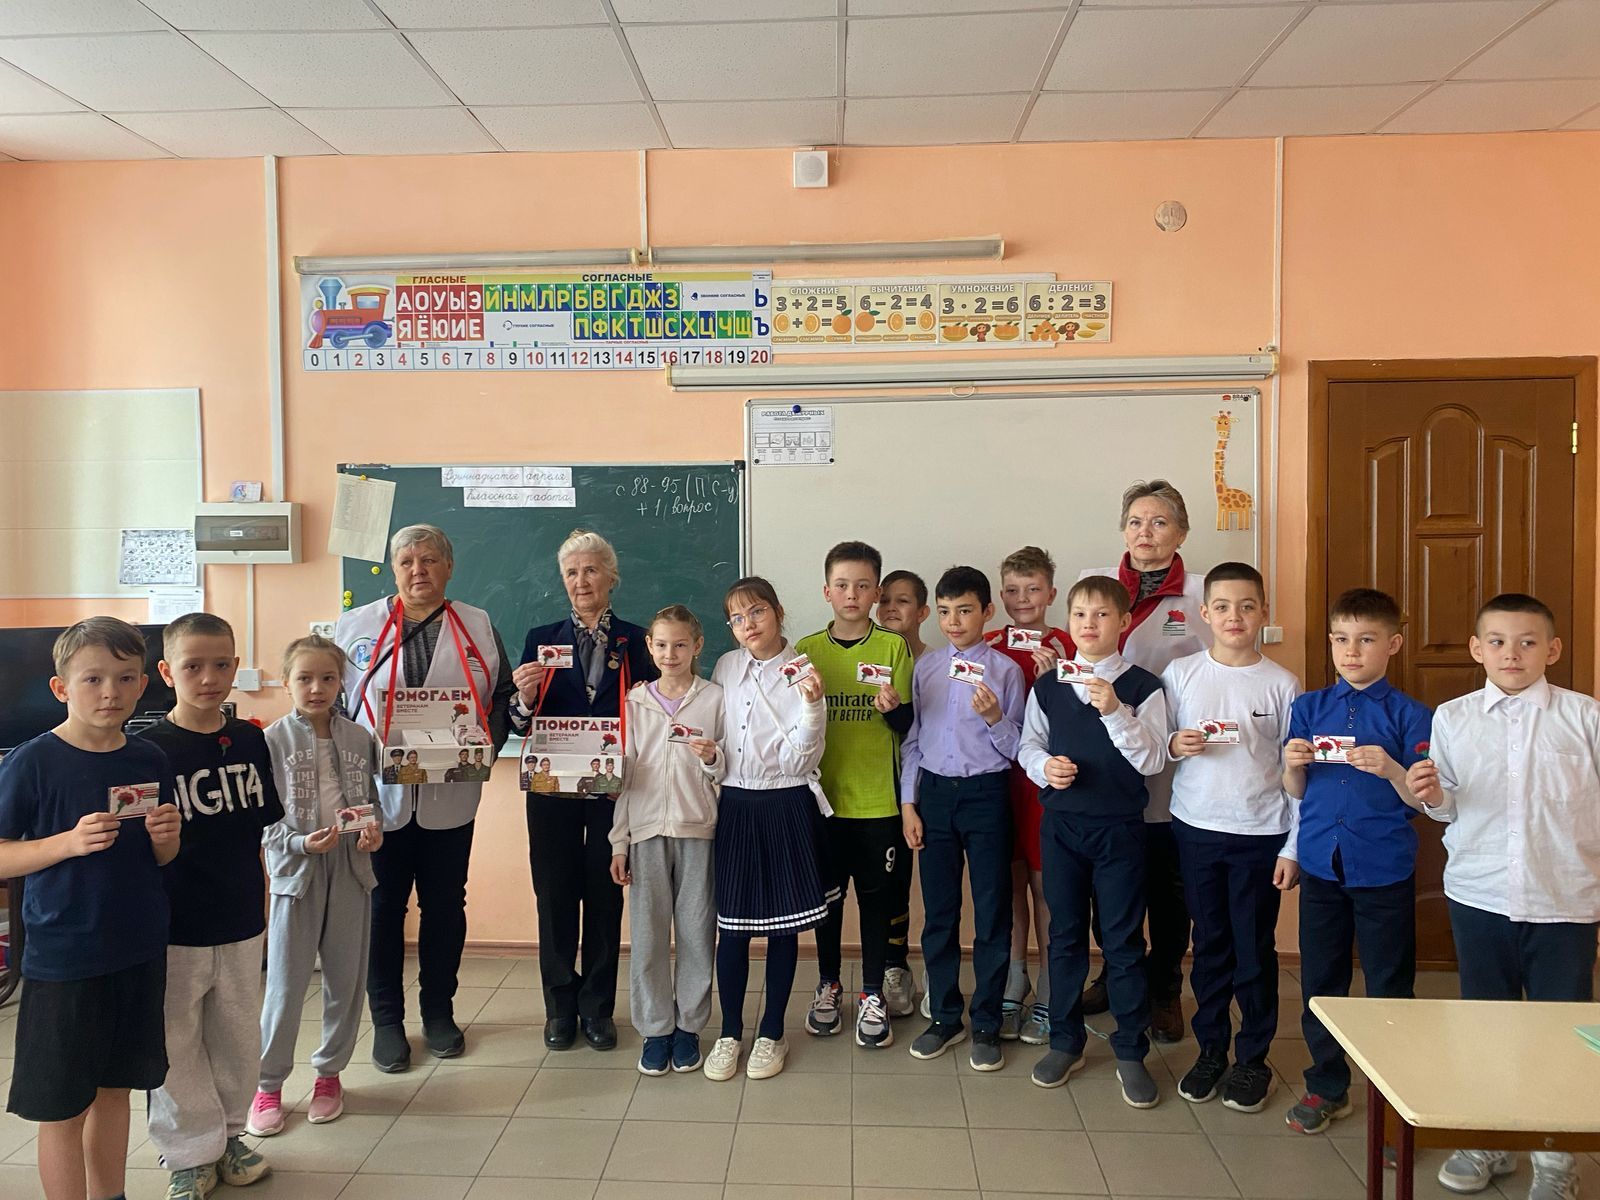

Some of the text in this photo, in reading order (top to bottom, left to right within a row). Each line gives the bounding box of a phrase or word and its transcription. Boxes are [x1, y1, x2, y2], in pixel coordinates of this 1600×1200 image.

[412, 275, 467, 285] ГЛАСНЫЕ
[582, 273, 653, 283] СОГЛАСНЫЕ
[790, 287, 839, 295] СЛОЖЕНИЕ
[871, 284, 927, 293] ВЫЧИТАНИЕ
[951, 284, 1014, 293] УМНОЖЕНИЕ
[1048, 283, 1093, 293] ДЕЛЕНИЕ
[754, 288, 768, 307] Ь
[776, 296, 788, 312] 3
[807, 296, 818, 311] 2
[836, 296, 847, 310] 5
[860, 295, 871, 310] 6
[891, 295, 902, 310] 2
[920, 294, 932, 309] 4
[1029, 295, 1041, 311] 6
[1061, 294, 1074, 311] 2
[1093, 295, 1106, 311] 3
[942, 298, 955, 314] 3
[974, 297, 987, 313] 2
[1006, 296, 1019, 313] 6
[754, 316, 770, 336] Ъ
[310, 350, 768, 366] 0 1 2 3 4 5 6 7 8 9 10 11 12 13 14 15 16 17 18 19 20
[825, 692, 875, 706] mirate
[840, 709, 873, 721] BETTER
[535, 719, 620, 732] ПОМОГАЕМ
[885, 846, 896, 873] 9
